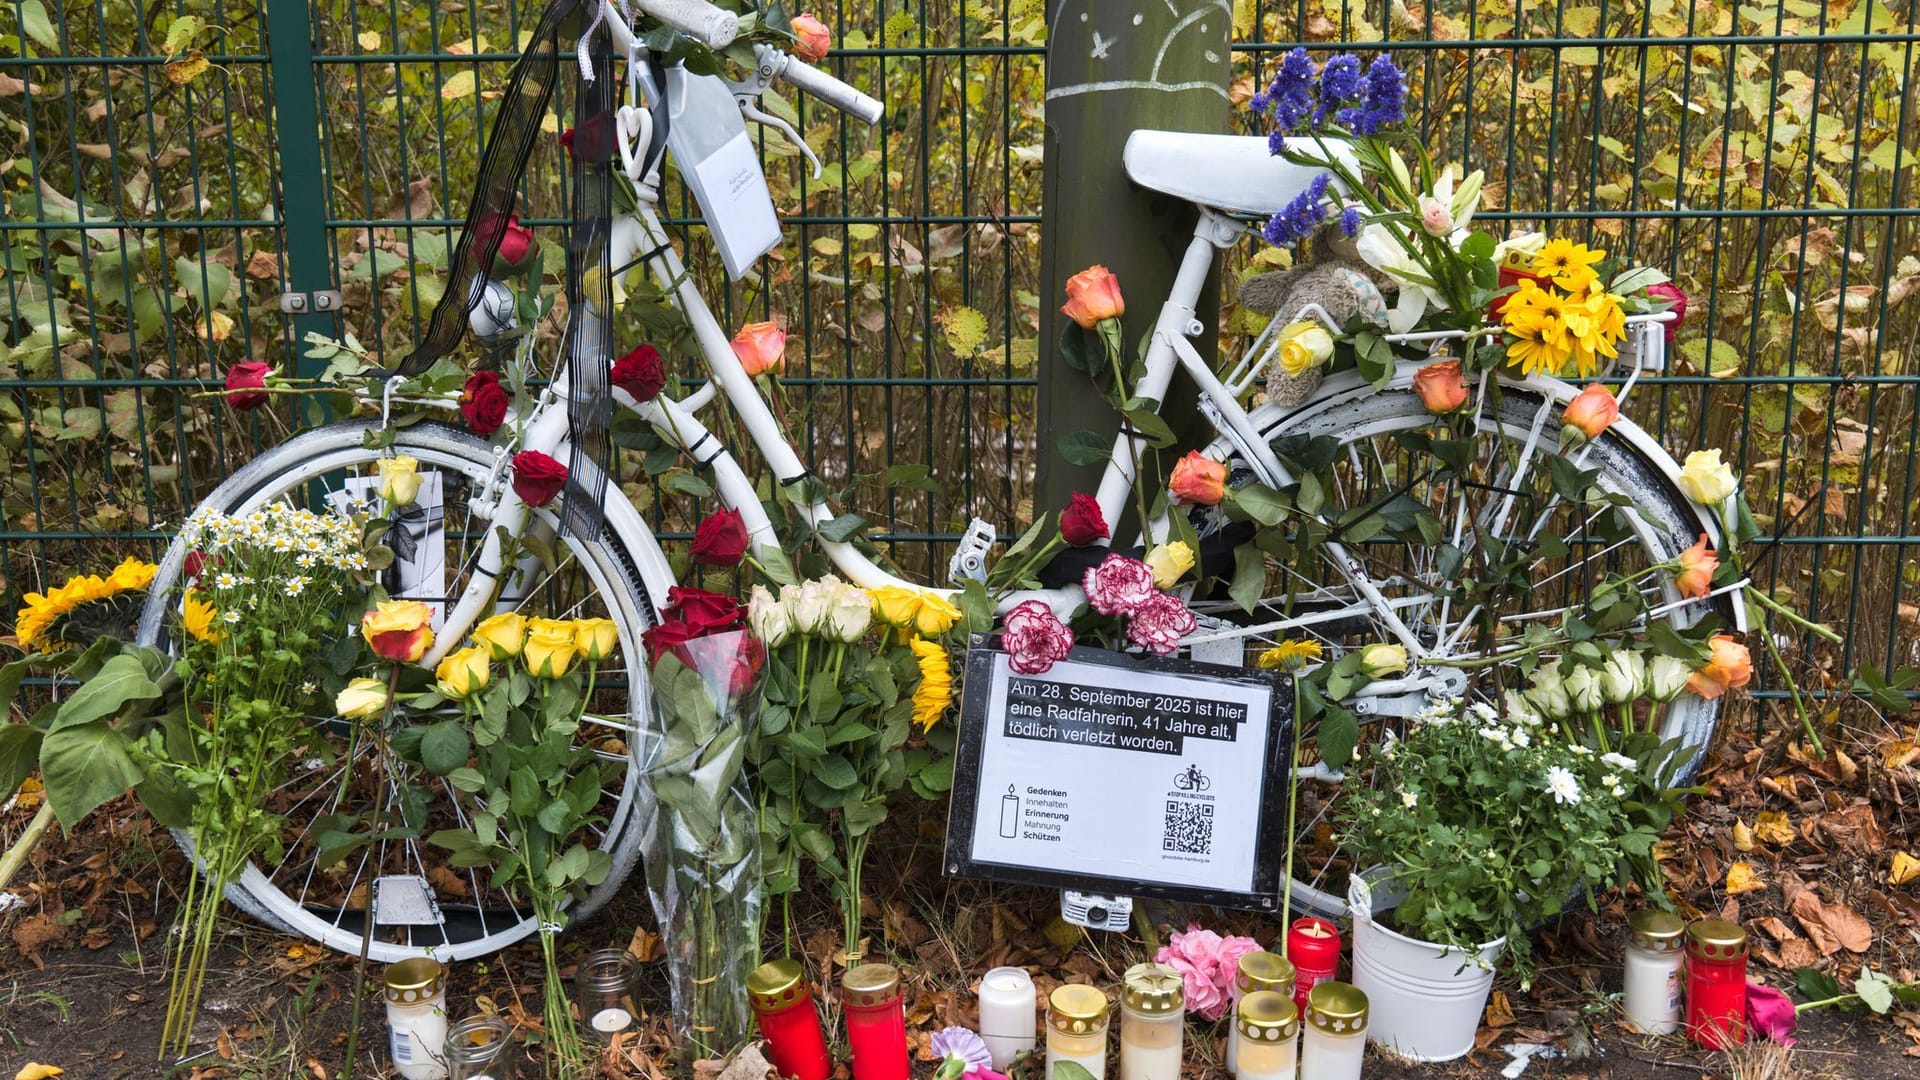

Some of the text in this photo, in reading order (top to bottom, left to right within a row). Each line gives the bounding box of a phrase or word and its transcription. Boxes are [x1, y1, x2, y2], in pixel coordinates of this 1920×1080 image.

[1011, 680, 1244, 720] Am 28. September 2025 ist hier
[1010, 701, 1231, 740] eine Radfahrerin, 41 Jahre alt,
[1009, 720, 1177, 752] tödlich verletzt worden.
[1026, 786, 1067, 797] Gedenken
[1025, 797, 1068, 809] Innehalten
[1025, 808, 1069, 822] Erinnerung
[1024, 820, 1061, 832] Mahnung
[1023, 831, 1061, 842] Schützen
